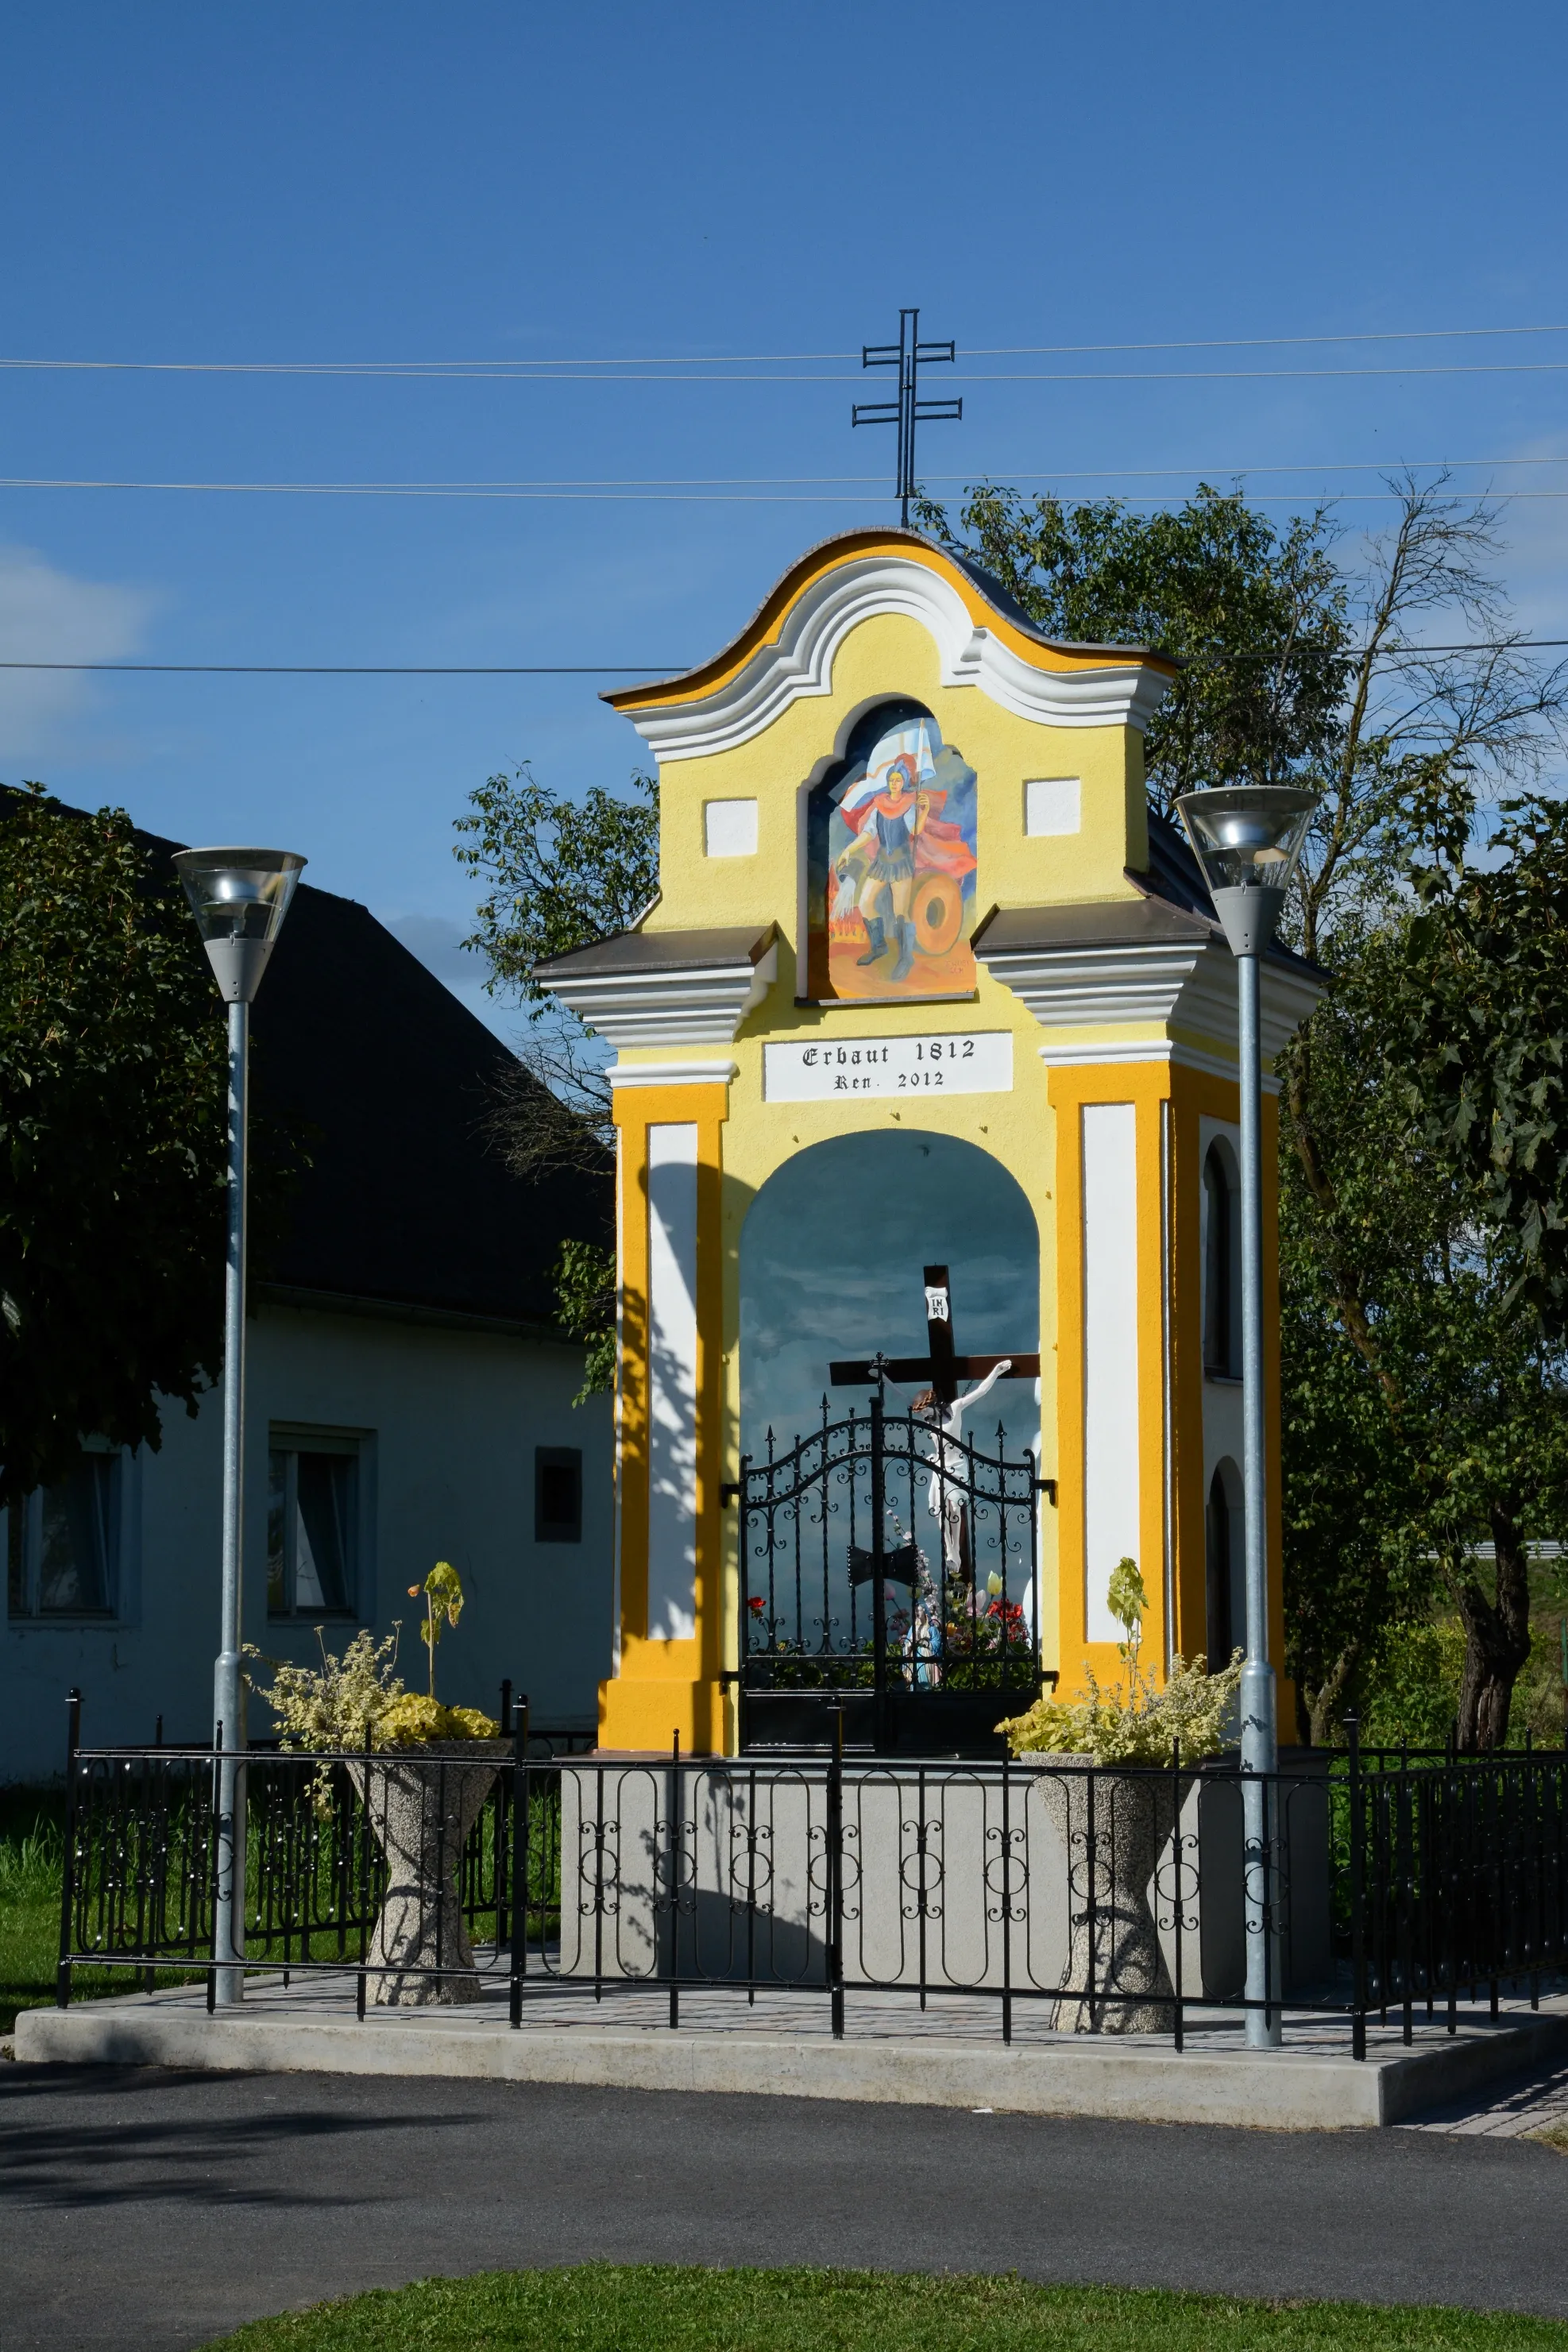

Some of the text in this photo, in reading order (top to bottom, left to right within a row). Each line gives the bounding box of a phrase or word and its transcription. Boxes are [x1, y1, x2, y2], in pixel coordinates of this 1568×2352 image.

[802, 1040, 975, 1067] Erbaut 1812
[833, 1071, 944, 1091] Ren. 2012
[932, 1299, 943, 1307] IN
[933, 1307, 944, 1316] RI
